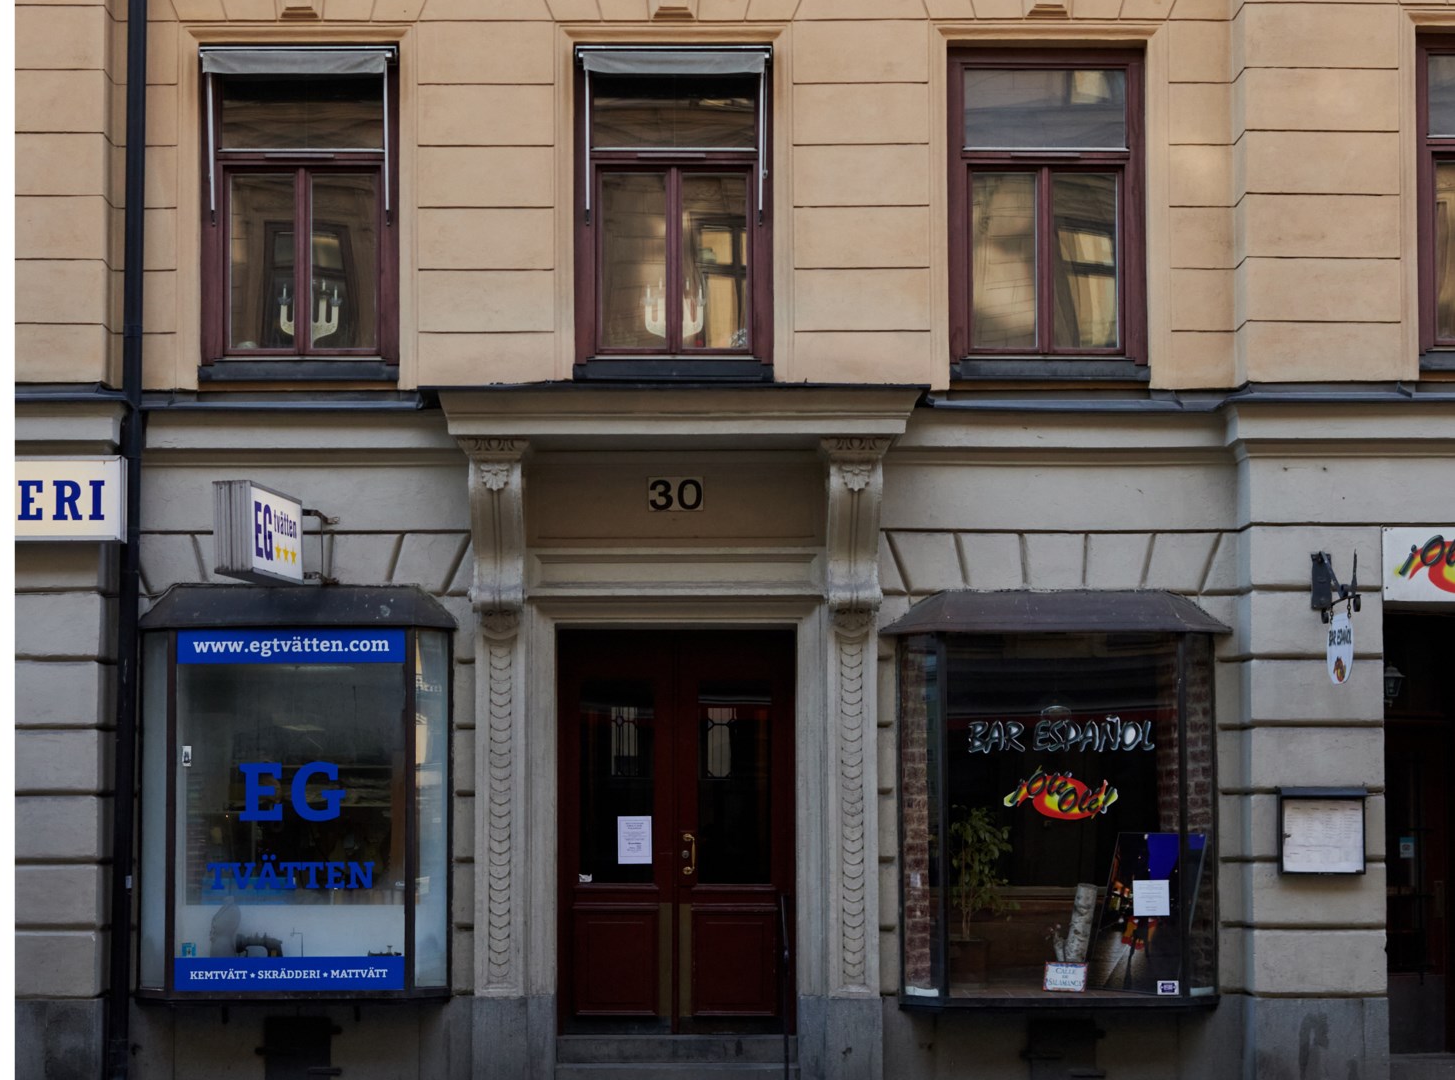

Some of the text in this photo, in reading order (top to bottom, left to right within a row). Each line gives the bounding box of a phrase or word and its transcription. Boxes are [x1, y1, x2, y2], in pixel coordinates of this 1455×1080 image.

[18, 480, 105, 521] ERI
[649, 478, 703, 511] 30
[254, 500, 297, 561] EG tvätten
[192, 636, 390, 658] www.egtvätten.com
[968, 715, 1155, 754] BAR ESPAÑOL
[239, 761, 347, 822] EG
[206, 853, 375, 890] TVÄTTEN
[189, 966, 388, 980] KEMTVÄTT SKRÄDDERI MATTVÄTT
